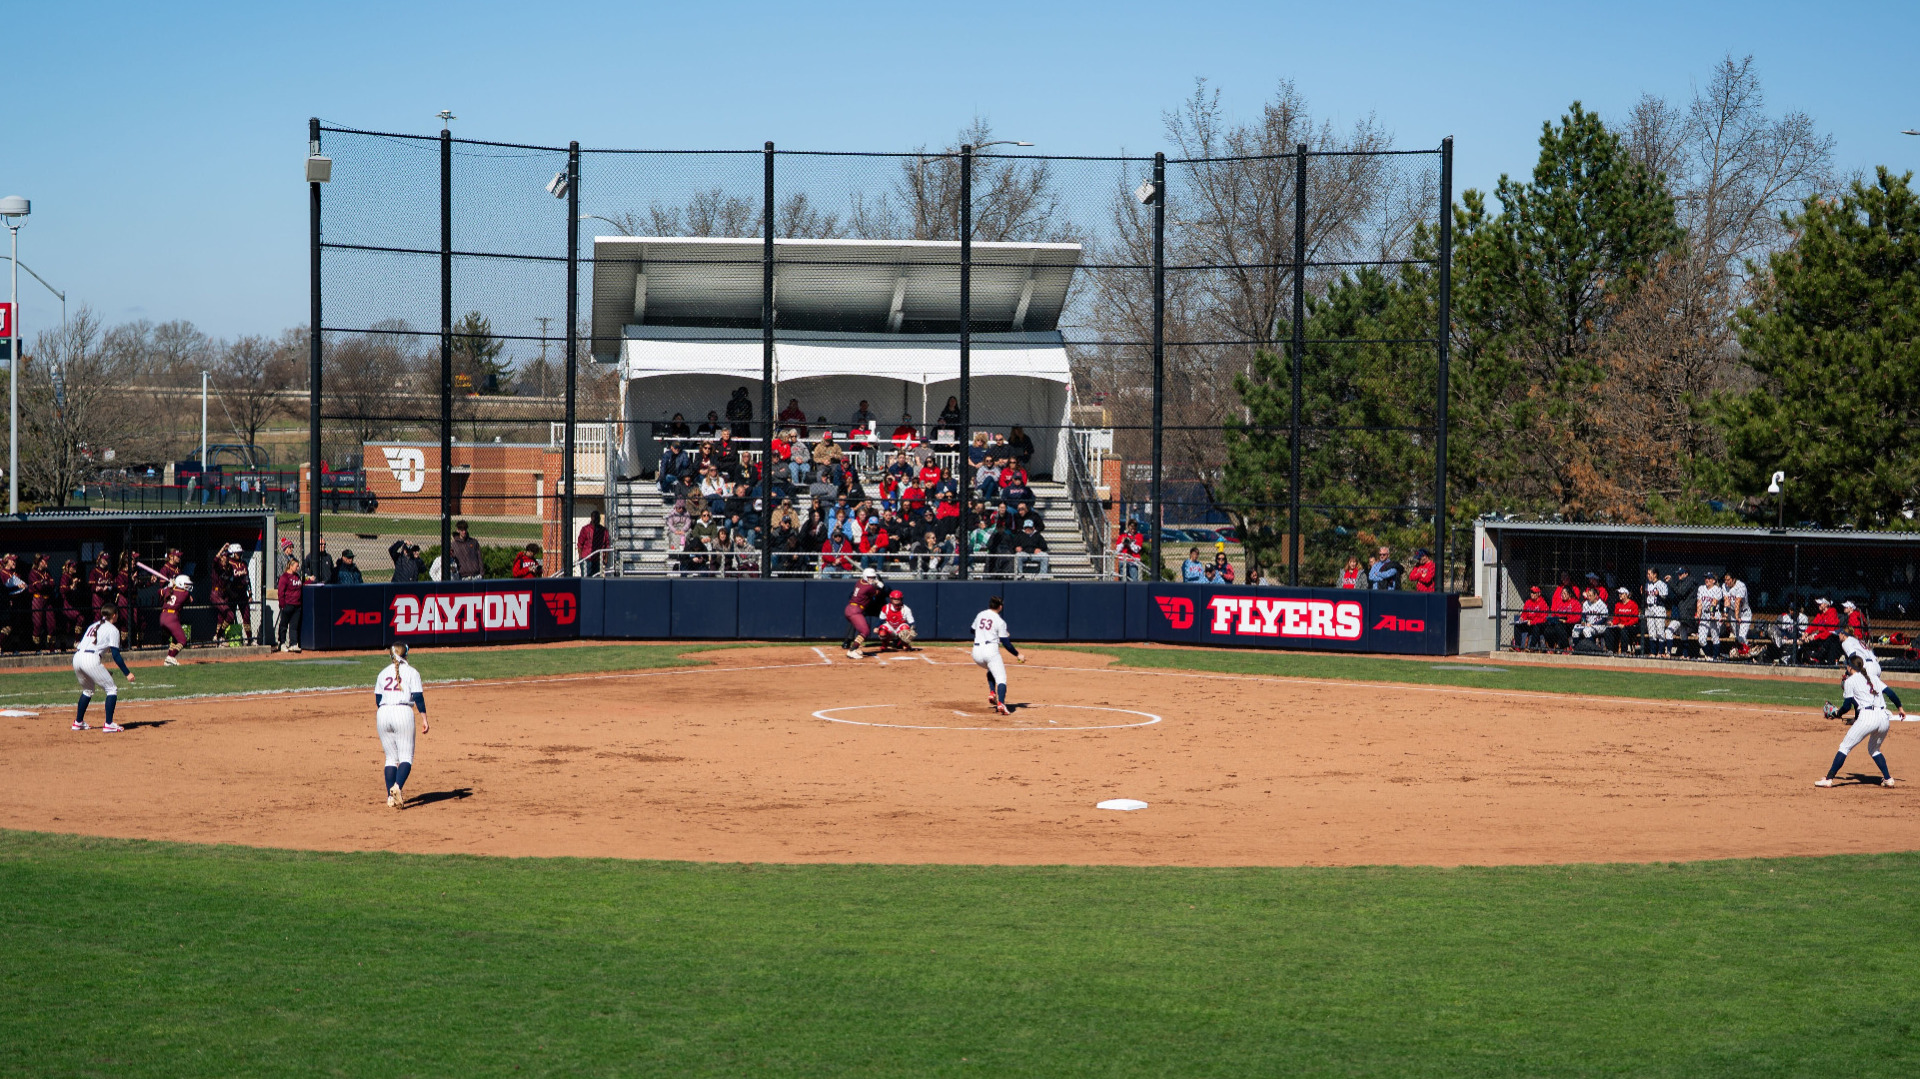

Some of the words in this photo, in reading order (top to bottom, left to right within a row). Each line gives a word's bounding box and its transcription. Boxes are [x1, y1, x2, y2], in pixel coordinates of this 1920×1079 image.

[335, 609, 382, 626] A10
[391, 592, 532, 634] DAYTON
[1209, 596, 1362, 640] FLYERS
[979, 618, 994, 631] 53
[1372, 615, 1425, 632] A10
[383, 676, 402, 692] 22
